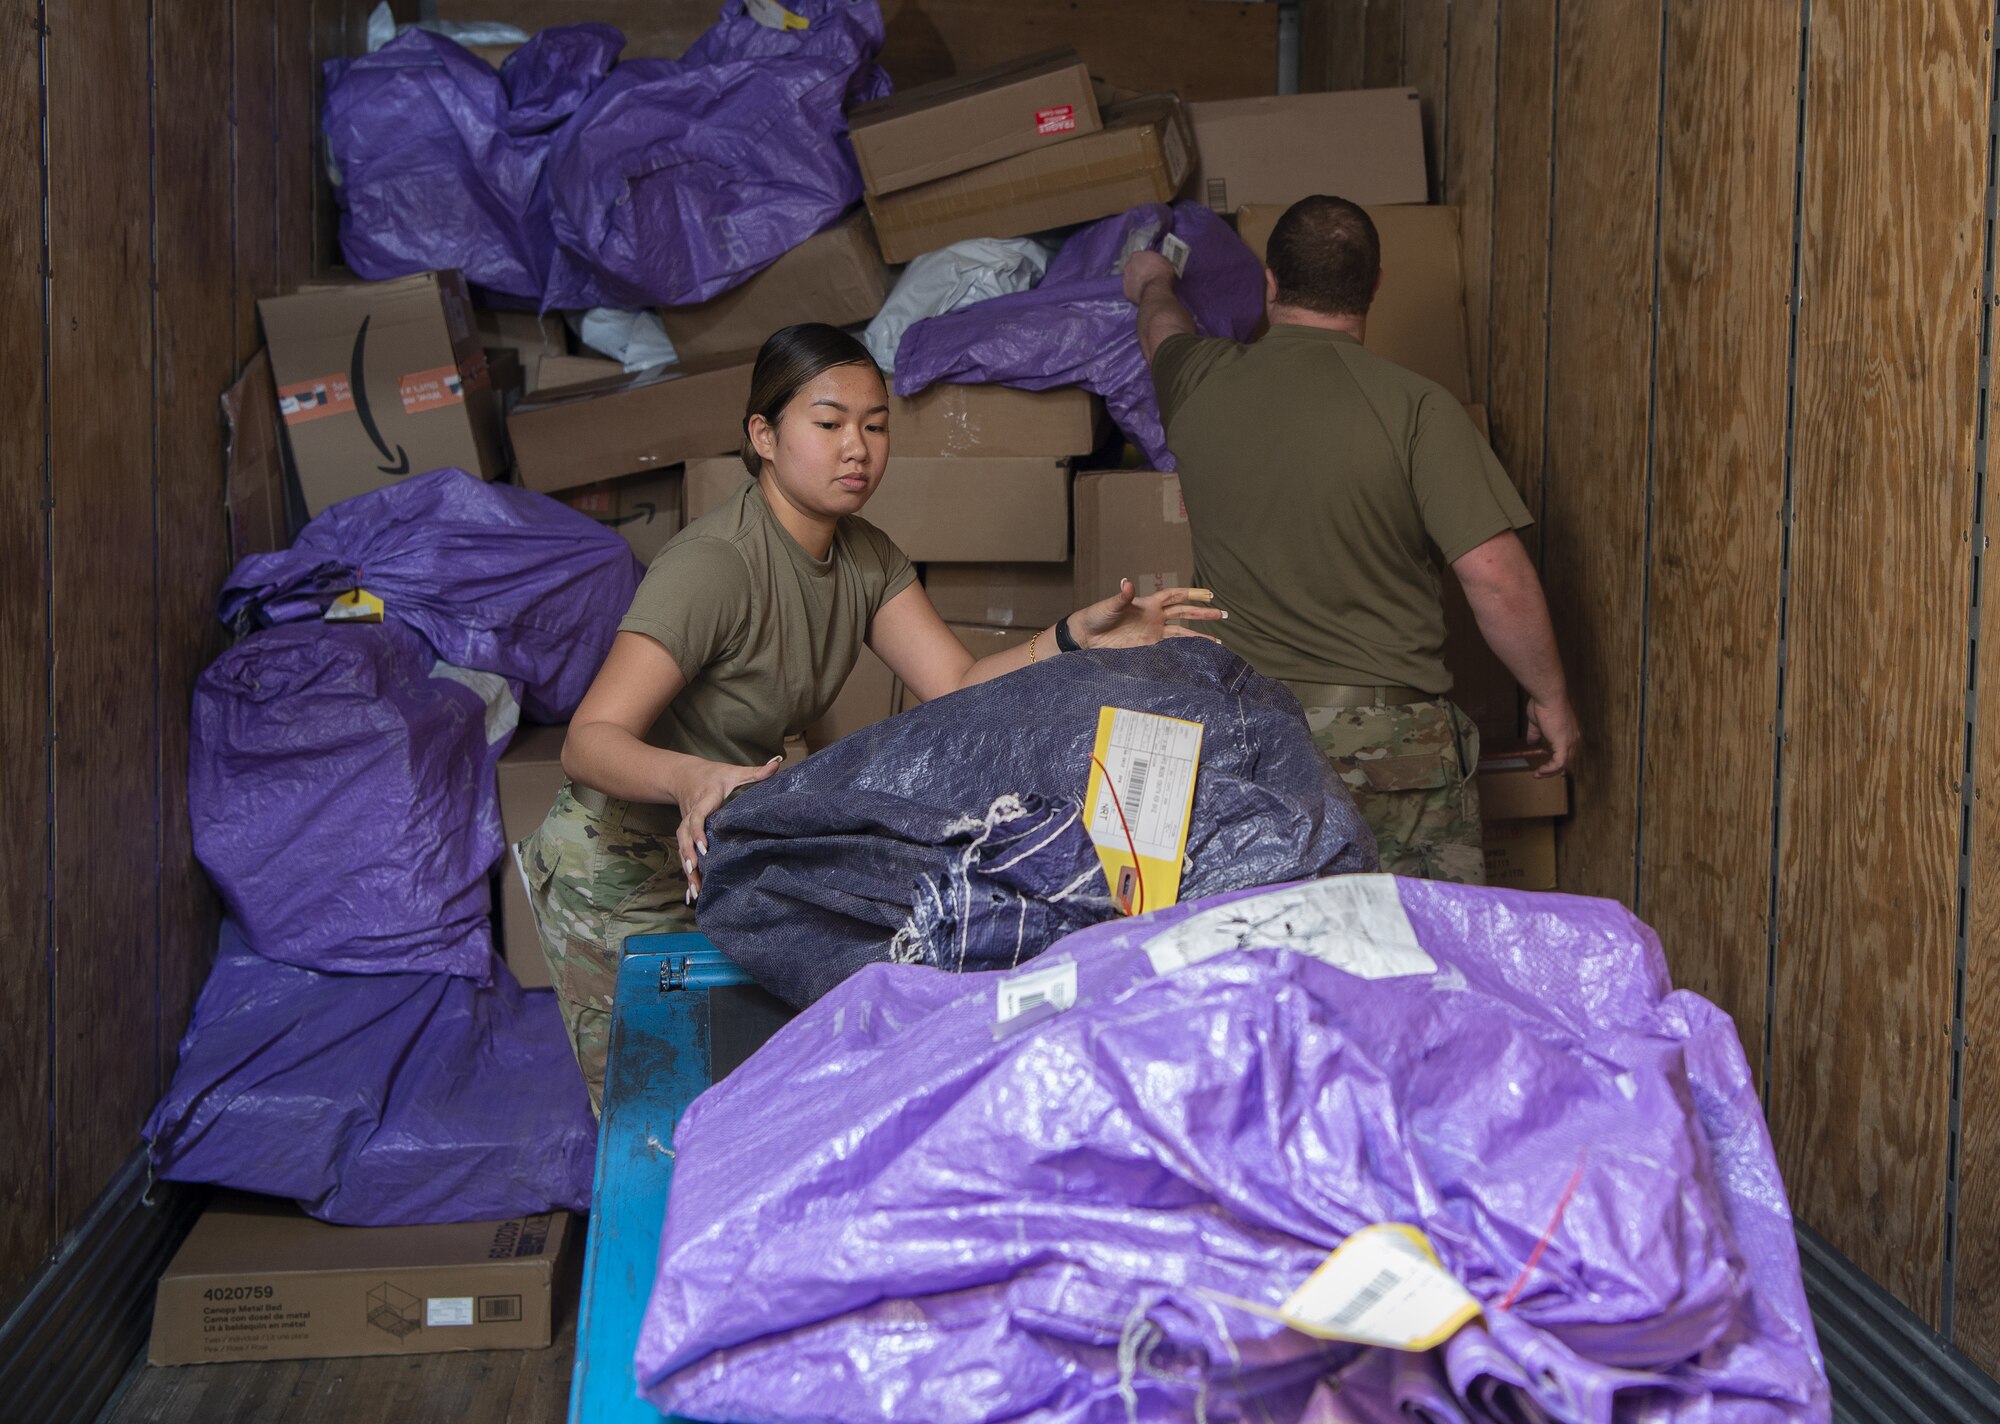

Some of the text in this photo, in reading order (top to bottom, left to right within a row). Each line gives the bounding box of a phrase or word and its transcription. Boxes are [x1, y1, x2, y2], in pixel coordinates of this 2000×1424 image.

[1039, 119, 1074, 134] FRAGILE
[203, 1285, 274, 1301] 4020759
[203, 1304, 282, 1315] Canopy Metal Bed
[203, 1315, 228, 1324] Cama
[248, 1313, 271, 1321] dosel
[273, 1312, 284, 1320] de
[286, 1311, 311, 1319] metal
[203, 1325, 217, 1333] Lit
[225, 1322, 267, 1332] baldaquin
[281, 1320, 306, 1328] métal
